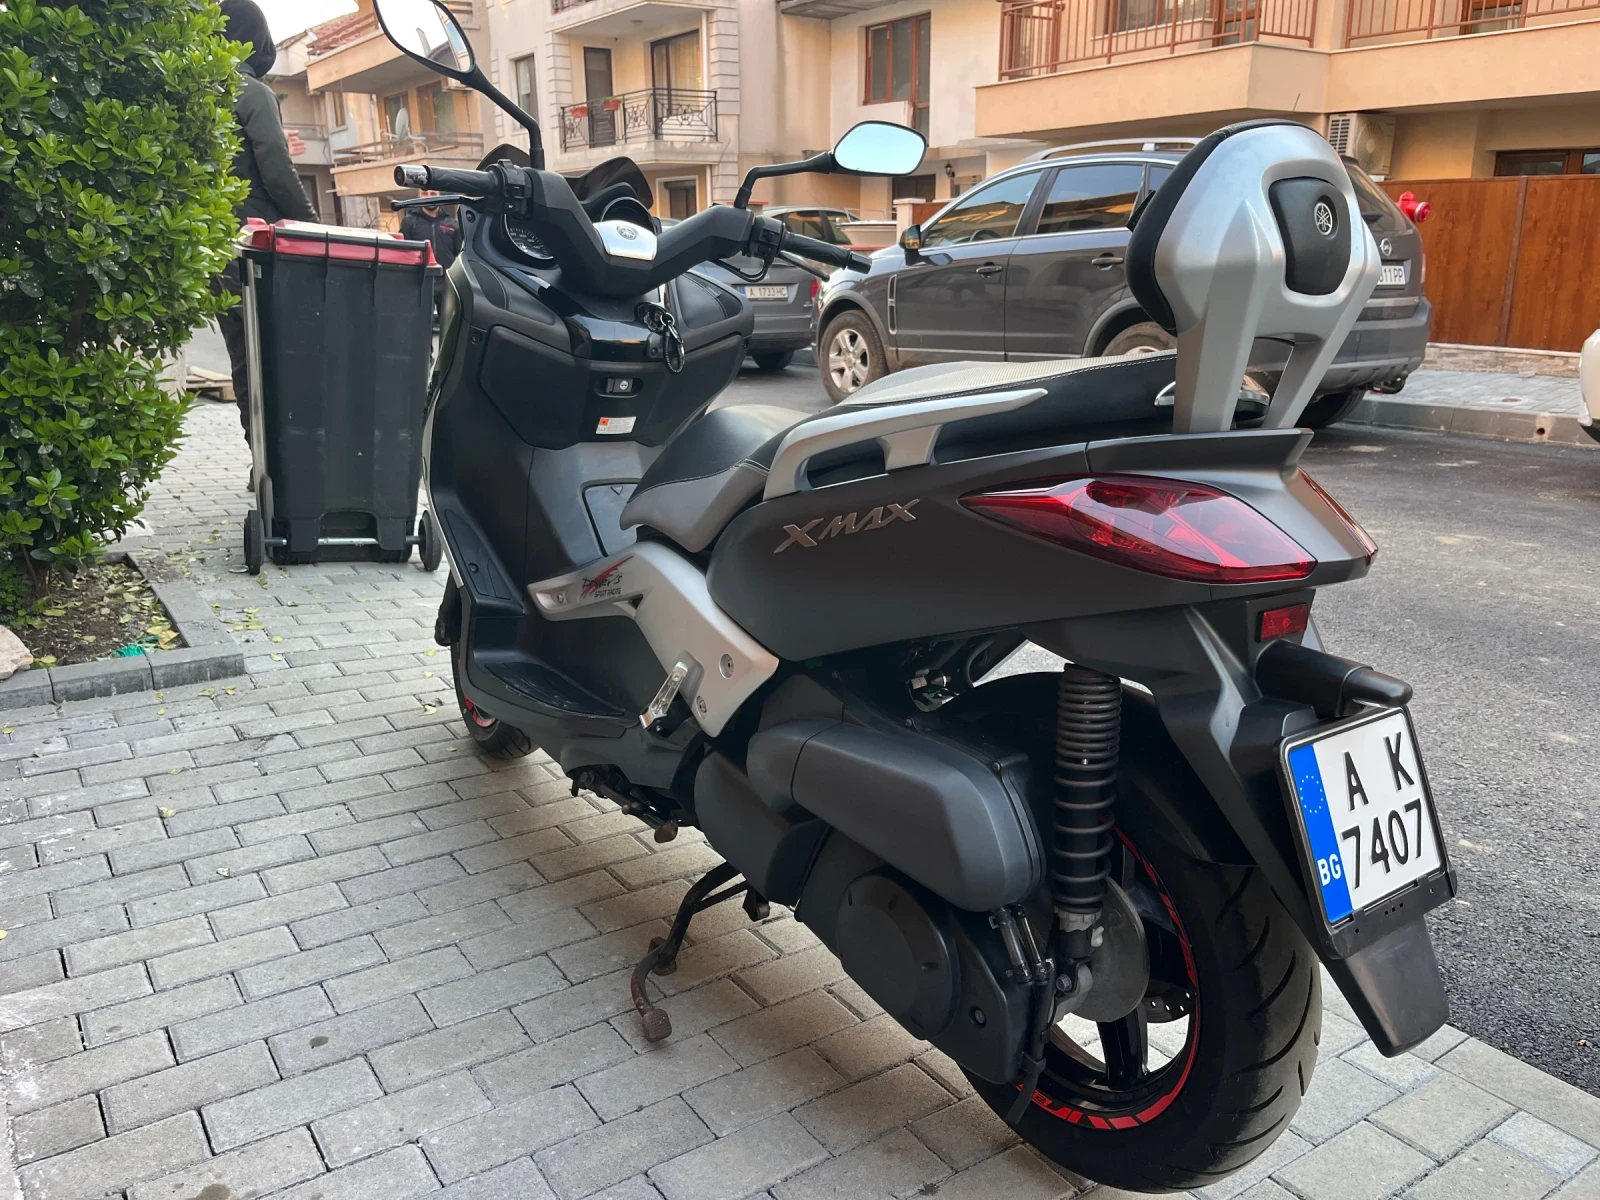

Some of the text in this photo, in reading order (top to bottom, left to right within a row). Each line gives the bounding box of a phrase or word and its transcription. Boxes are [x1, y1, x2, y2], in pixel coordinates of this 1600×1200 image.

[749, 287, 755, 297] A
[773, 499, 920, 554] XMAX
[1344, 732, 1414, 811] A K
[1317, 854, 1342, 886] BG
[1341, 798, 1422, 889] 7407
